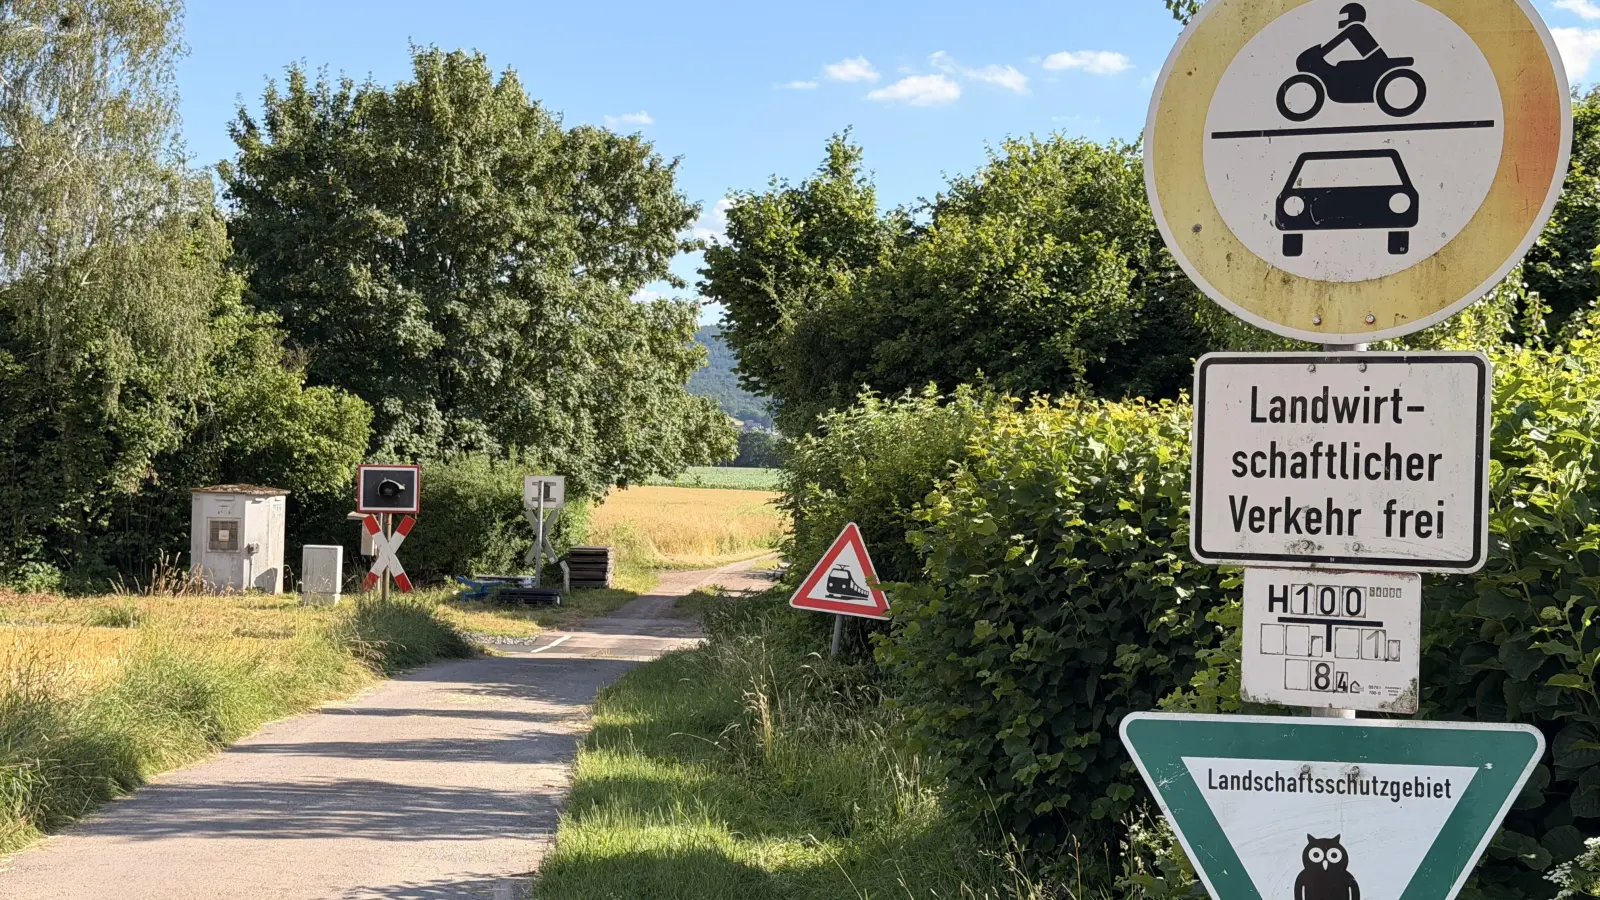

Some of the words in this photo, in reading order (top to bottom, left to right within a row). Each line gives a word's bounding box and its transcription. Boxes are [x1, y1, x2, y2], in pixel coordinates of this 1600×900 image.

[1250, 385, 1425, 424] Landwirt-
[1231, 440, 1443, 482] schaftlicher
[1228, 494, 1362, 537] Verkehr
[1383, 498, 1445, 539] frei
[1268, 584, 1362, 616] H100
[1208, 768, 1453, 803] Landschaftsschutzgebiet
